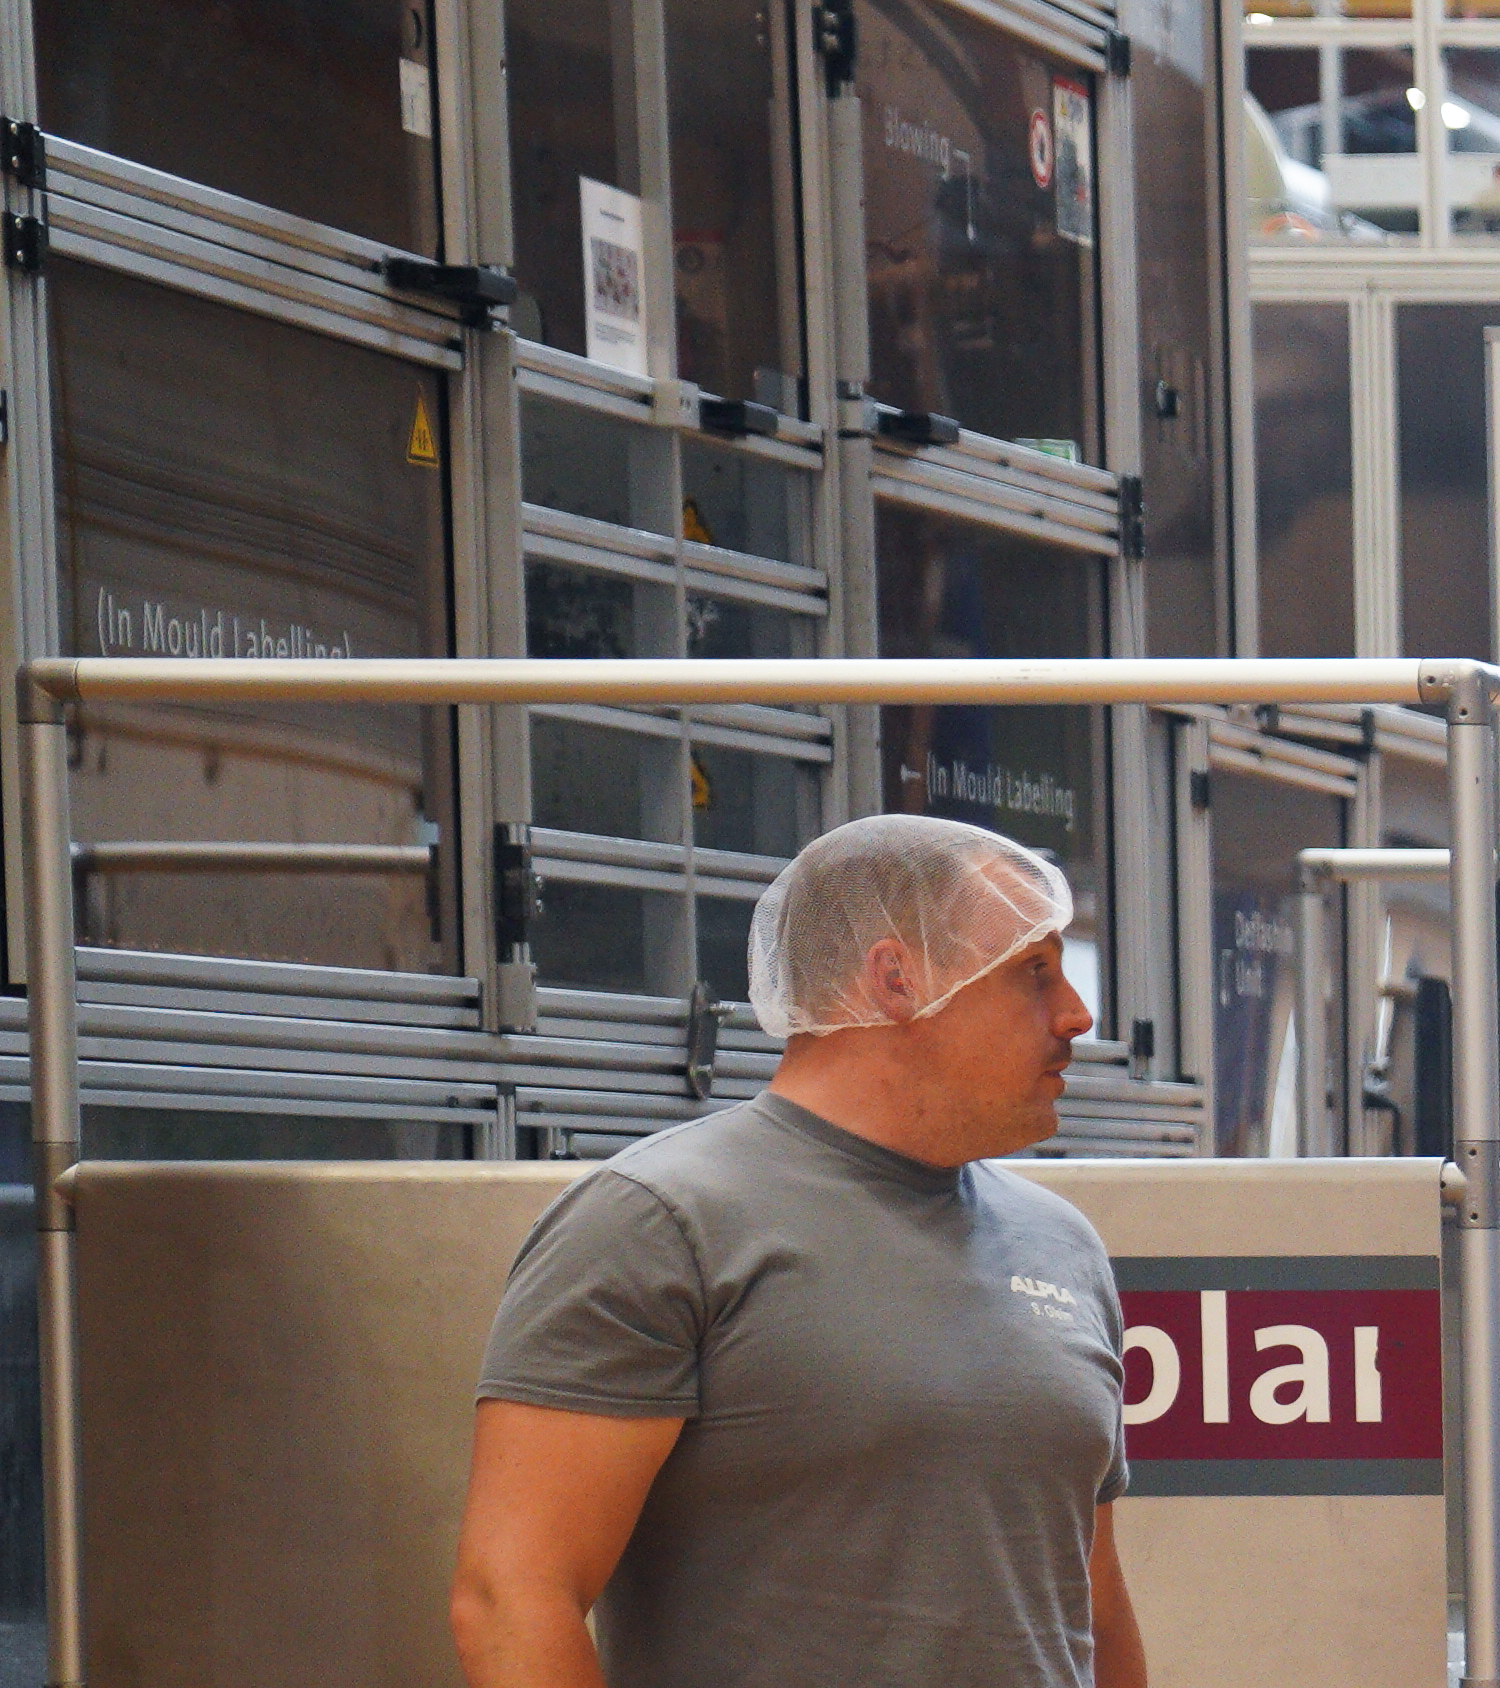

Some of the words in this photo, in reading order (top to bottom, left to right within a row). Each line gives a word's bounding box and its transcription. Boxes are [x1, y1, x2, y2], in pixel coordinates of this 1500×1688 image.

[98, 586, 131, 657] (In
[143, 601, 223, 658] Mould
[1122, 1289, 1383, 1425] plar
